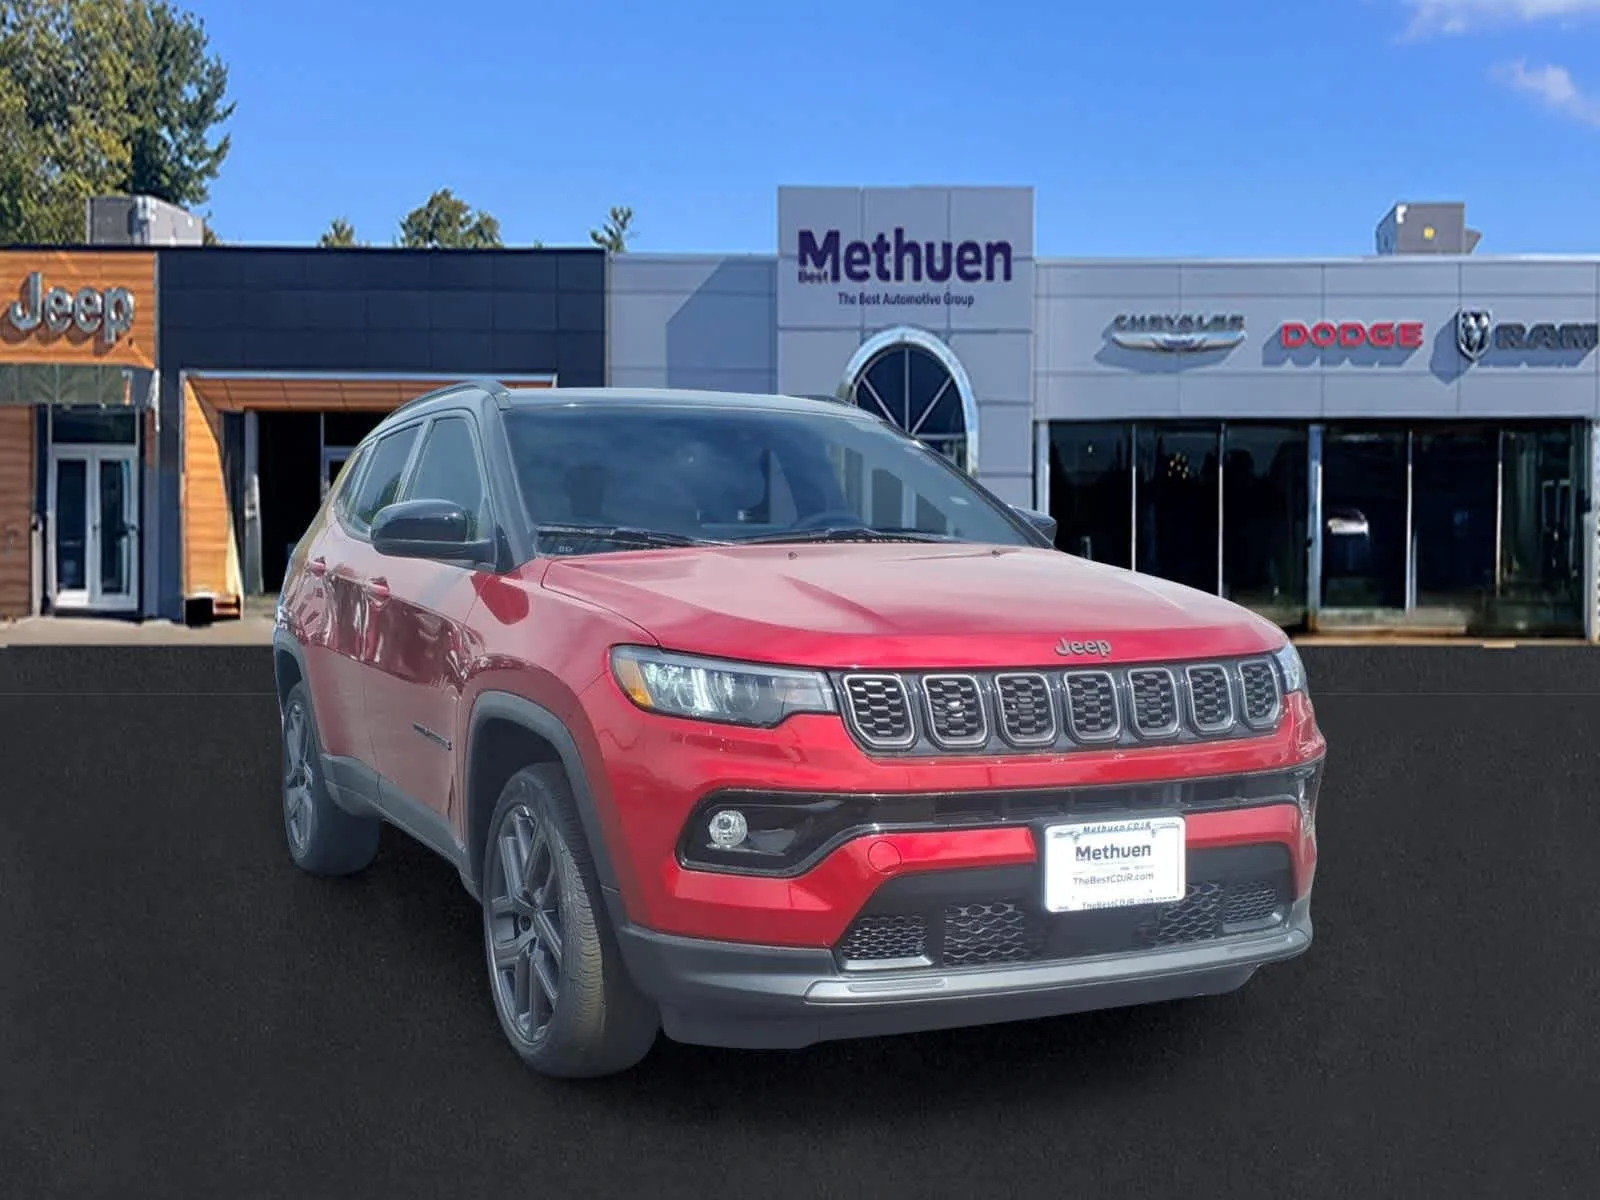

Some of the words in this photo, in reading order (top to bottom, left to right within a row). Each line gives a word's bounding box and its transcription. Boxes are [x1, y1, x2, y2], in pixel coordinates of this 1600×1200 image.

[798, 227, 1012, 282] Methuen
[8, 271, 135, 345] Jeep
[838, 292, 857, 305] The
[859, 292, 880, 305] Best
[882, 292, 941, 305] Automotive
[943, 292, 975, 308] Group
[1281, 322, 1424, 348] DODGE
[1495, 322, 1599, 350] RAM
[1055, 637, 1112, 657] Jeep
[1083, 823, 1125, 833] Methuen
[1075, 843, 1152, 862] Methuen
